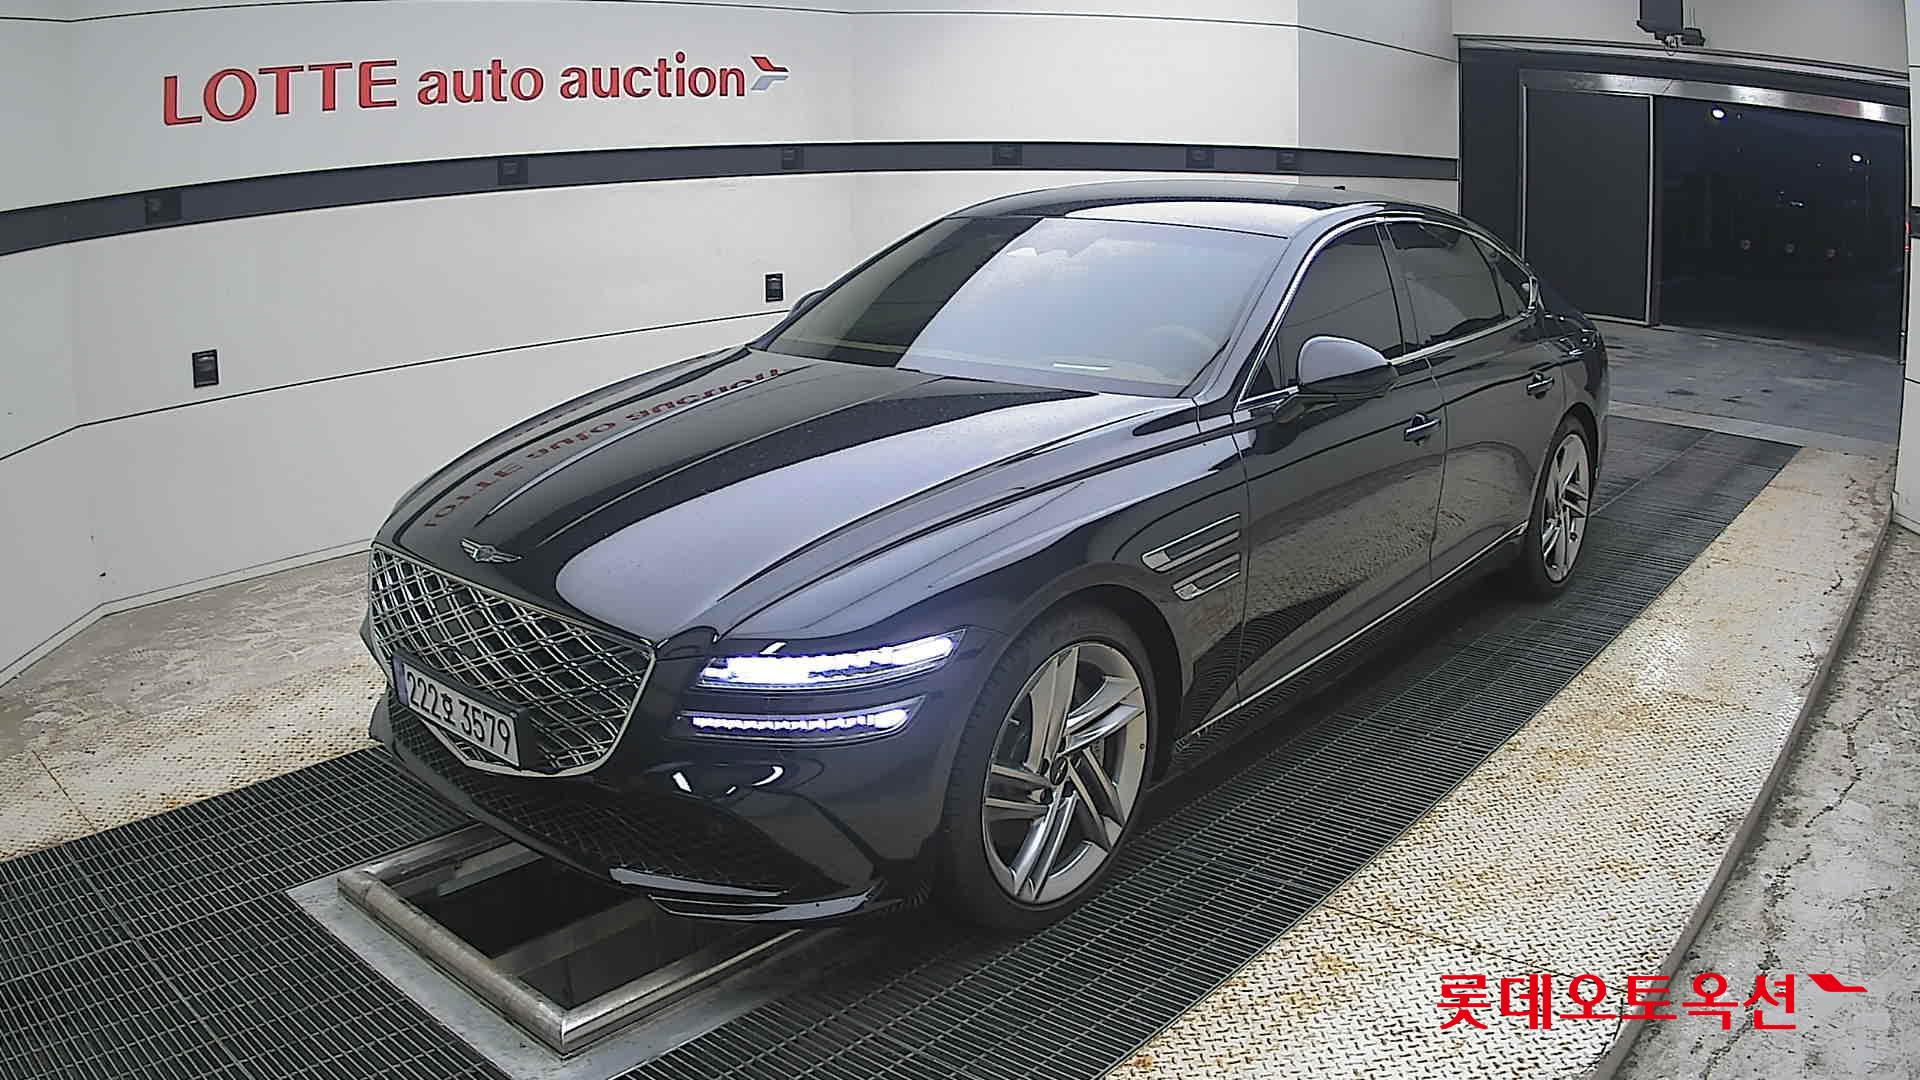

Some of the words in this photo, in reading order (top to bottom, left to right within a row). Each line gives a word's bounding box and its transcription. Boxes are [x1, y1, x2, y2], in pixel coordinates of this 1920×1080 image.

[163, 60, 398, 126] LOTTE
[417, 60, 544, 105] auto
[559, 51, 746, 98] auction
[458, 699, 511, 755] 3579
